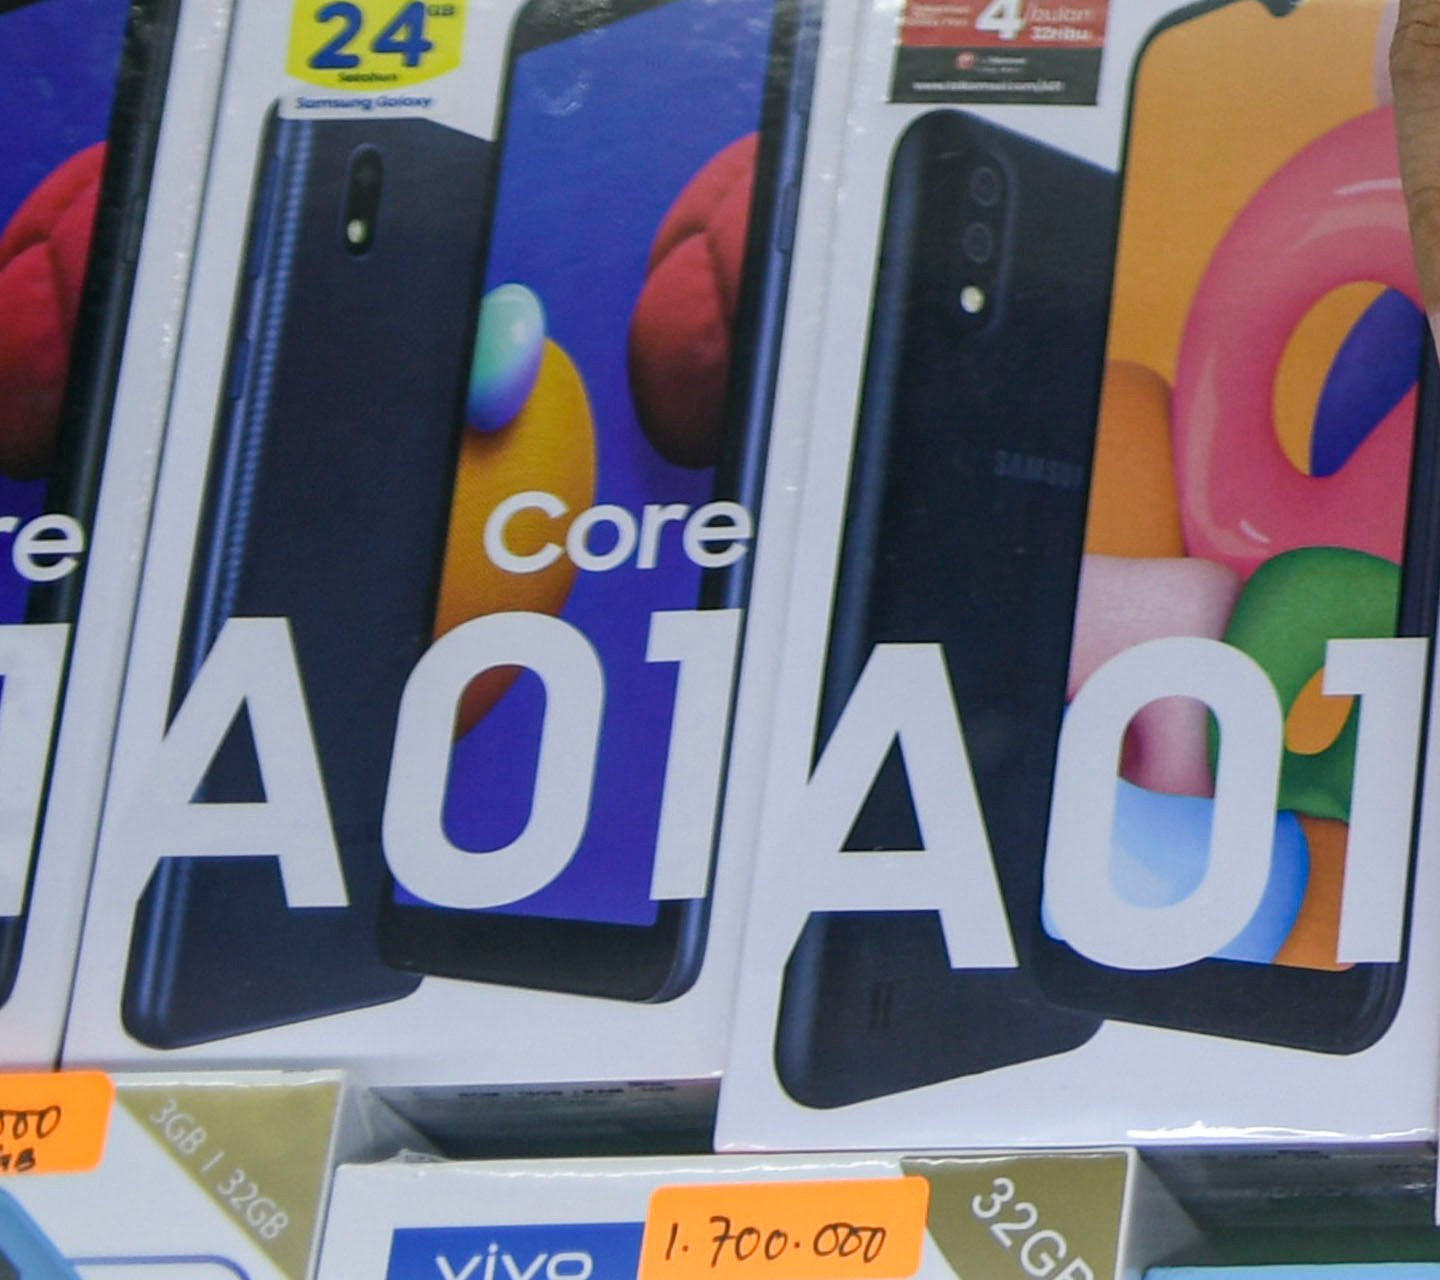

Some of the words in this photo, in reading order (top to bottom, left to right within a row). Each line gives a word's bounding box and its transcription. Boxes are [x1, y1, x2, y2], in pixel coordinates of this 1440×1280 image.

[308, 0, 434, 70] 24
[296, 95, 373, 115] Samsung
[376, 95, 434, 115] Galaxy
[483, 491, 753, 574] Core
[85, 608, 745, 910] A01
[720, 636, 1430, 971] A01
[434, 1243, 594, 1280] vivo
